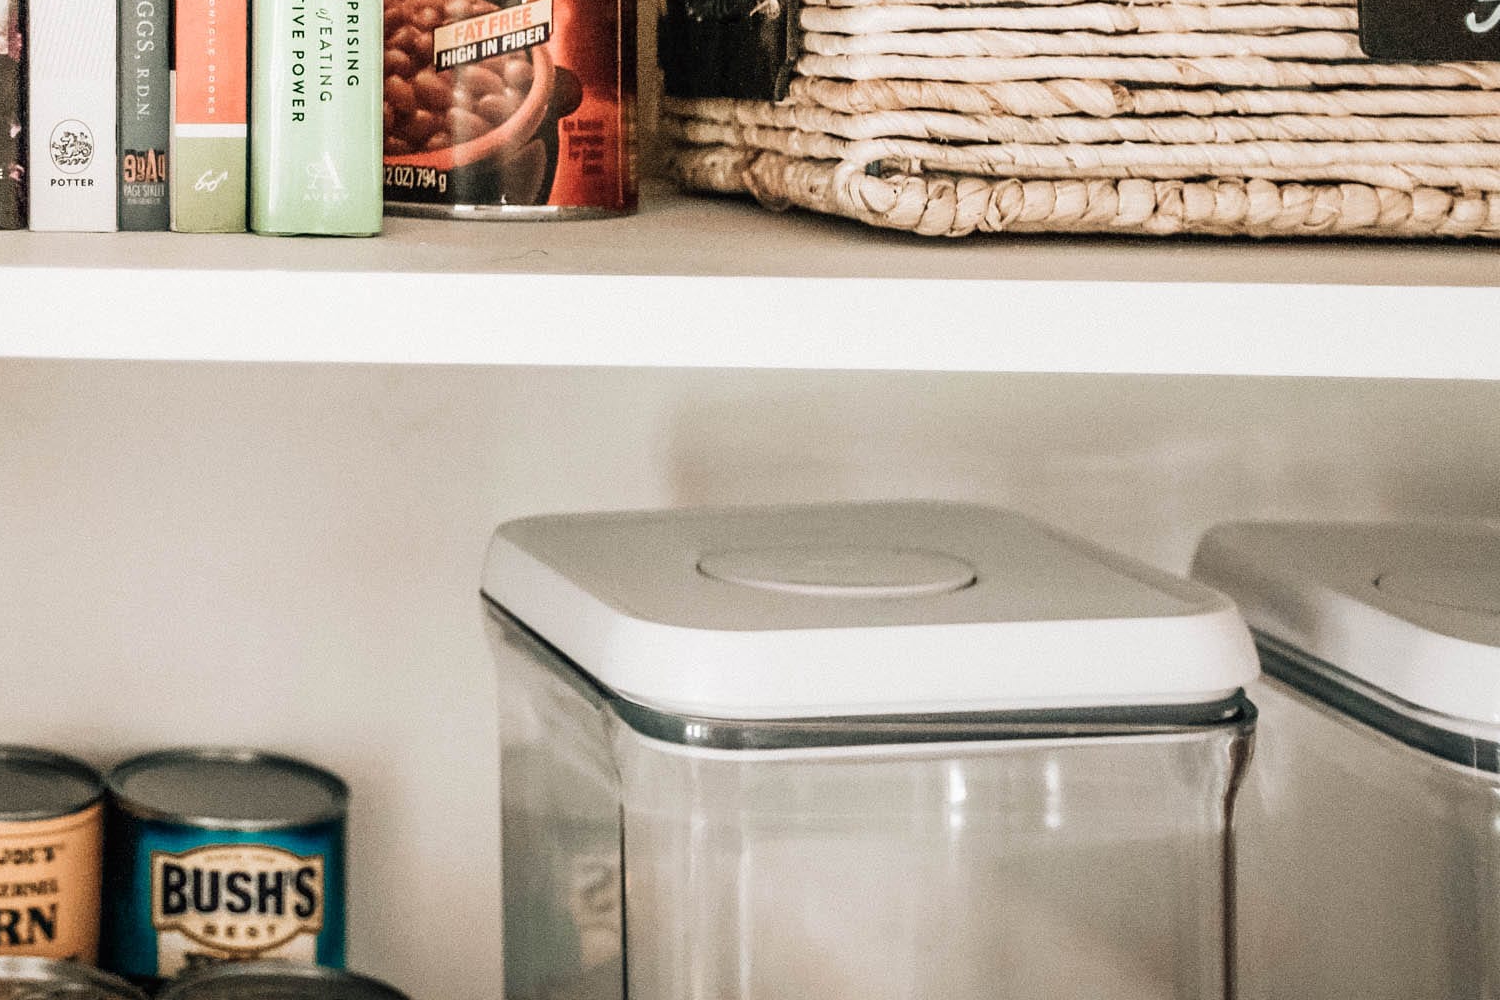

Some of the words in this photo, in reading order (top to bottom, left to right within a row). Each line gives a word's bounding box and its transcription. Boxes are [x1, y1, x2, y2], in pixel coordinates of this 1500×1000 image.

[316, 7, 333, 25] of
[453, 19, 486, 44] FAT
[488, 6, 533, 34] FREE
[319, 27, 333, 102] EATING
[441, 44, 477, 68] HIGH
[481, 36, 498, 57] IN
[502, 25, 545, 52] FIBER
[207, 64, 216, 114] BOOKS
[291, 50, 305, 122] POWER
[51, 178, 94, 187] POTTER
[416, 169, 436, 187] 794
[438, 173, 447, 193] g
[162, 862, 317, 918] BUSH'S
